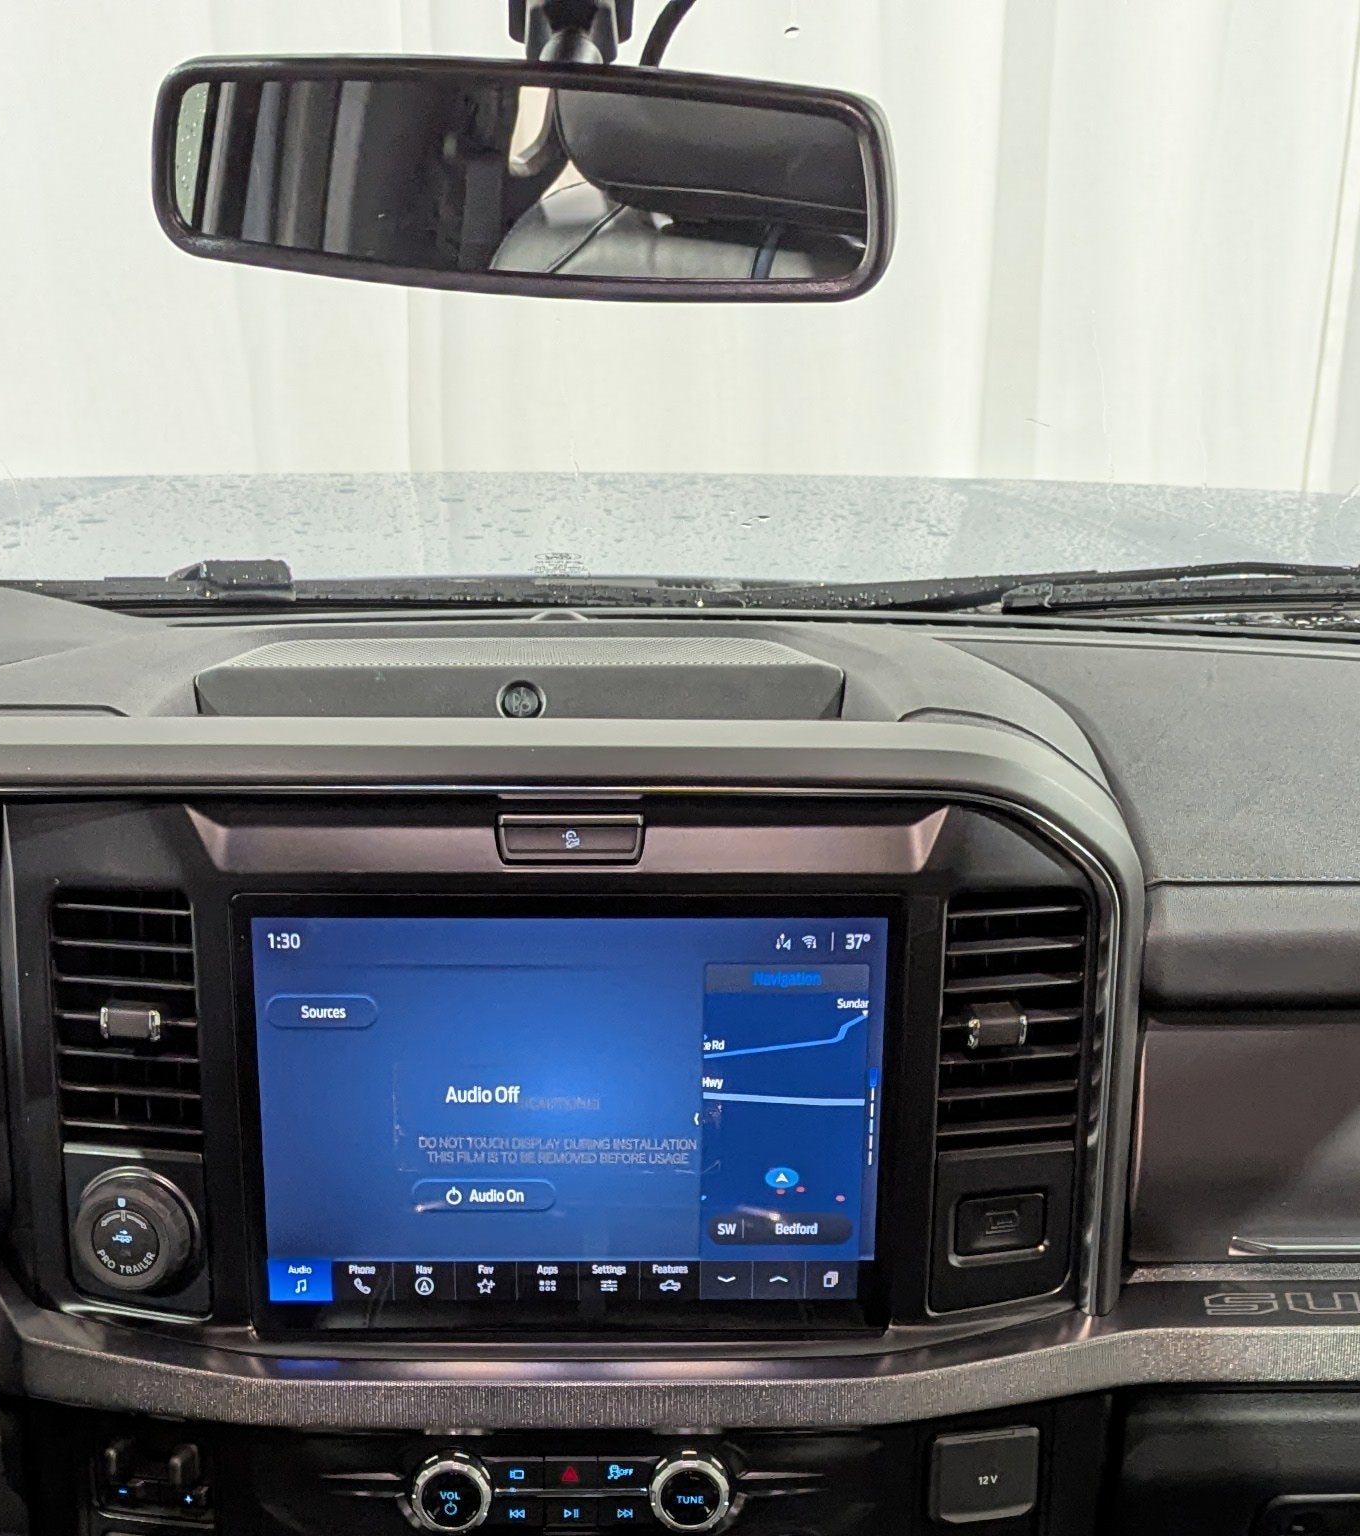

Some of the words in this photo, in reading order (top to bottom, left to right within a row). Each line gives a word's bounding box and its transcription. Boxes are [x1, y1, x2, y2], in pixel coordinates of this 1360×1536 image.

[267, 933, 301, 949] 1:30
[752, 971, 822, 988] Navigation
[301, 1005, 347, 1019] Sources
[712, 1039, 725, 1050] Rd
[702, 1076, 724, 1089] Hwy
[445, 1085, 492, 1103] Audio
[494, 1085, 520, 1103] Off
[418, 1136, 436, 1149] DO
[439, 1137, 464, 1149] NOT
[466, 1137, 508, 1149] TOUCH
[512, 1137, 560, 1150] DISPLAY
[564, 1138, 609, 1150] DURING
[613, 1138, 698, 1150] INSTALLATION
[427, 1151, 454, 1163] THIS
[457, 1151, 484, 1163] FILM
[488, 1151, 499, 1163] IS
[502, 1152, 517, 1163] TO
[538, 1152, 597, 1164] REMOVED
[600, 1152, 646, 1164] BEFORE
[649, 1152, 689, 1164] USAGE
[469, 1189, 505, 1203] Audio
[506, 1189, 525, 1203] On
[717, 1223, 737, 1235] SW
[775, 1222, 819, 1235] Bedford
[97, 1249, 116, 1269] PRO
[120, 1251, 156, 1274] TRAILER
[288, 1265, 312, 1275] Audio
[348, 1265, 376, 1275] Phone
[415, 1265, 433, 1275] Nav
[478, 1265, 494, 1275] Fav
[536, 1265, 559, 1277] Apps
[592, 1265, 627, 1277] Settings
[652, 1265, 689, 1275] Features
[619, 1467, 634, 1476] OFF
[978, 1476, 989, 1486] 12
[990, 1475, 998, 1484] V
[440, 1491, 461, 1500] VOL
[676, 1495, 705, 1505] TUNE
